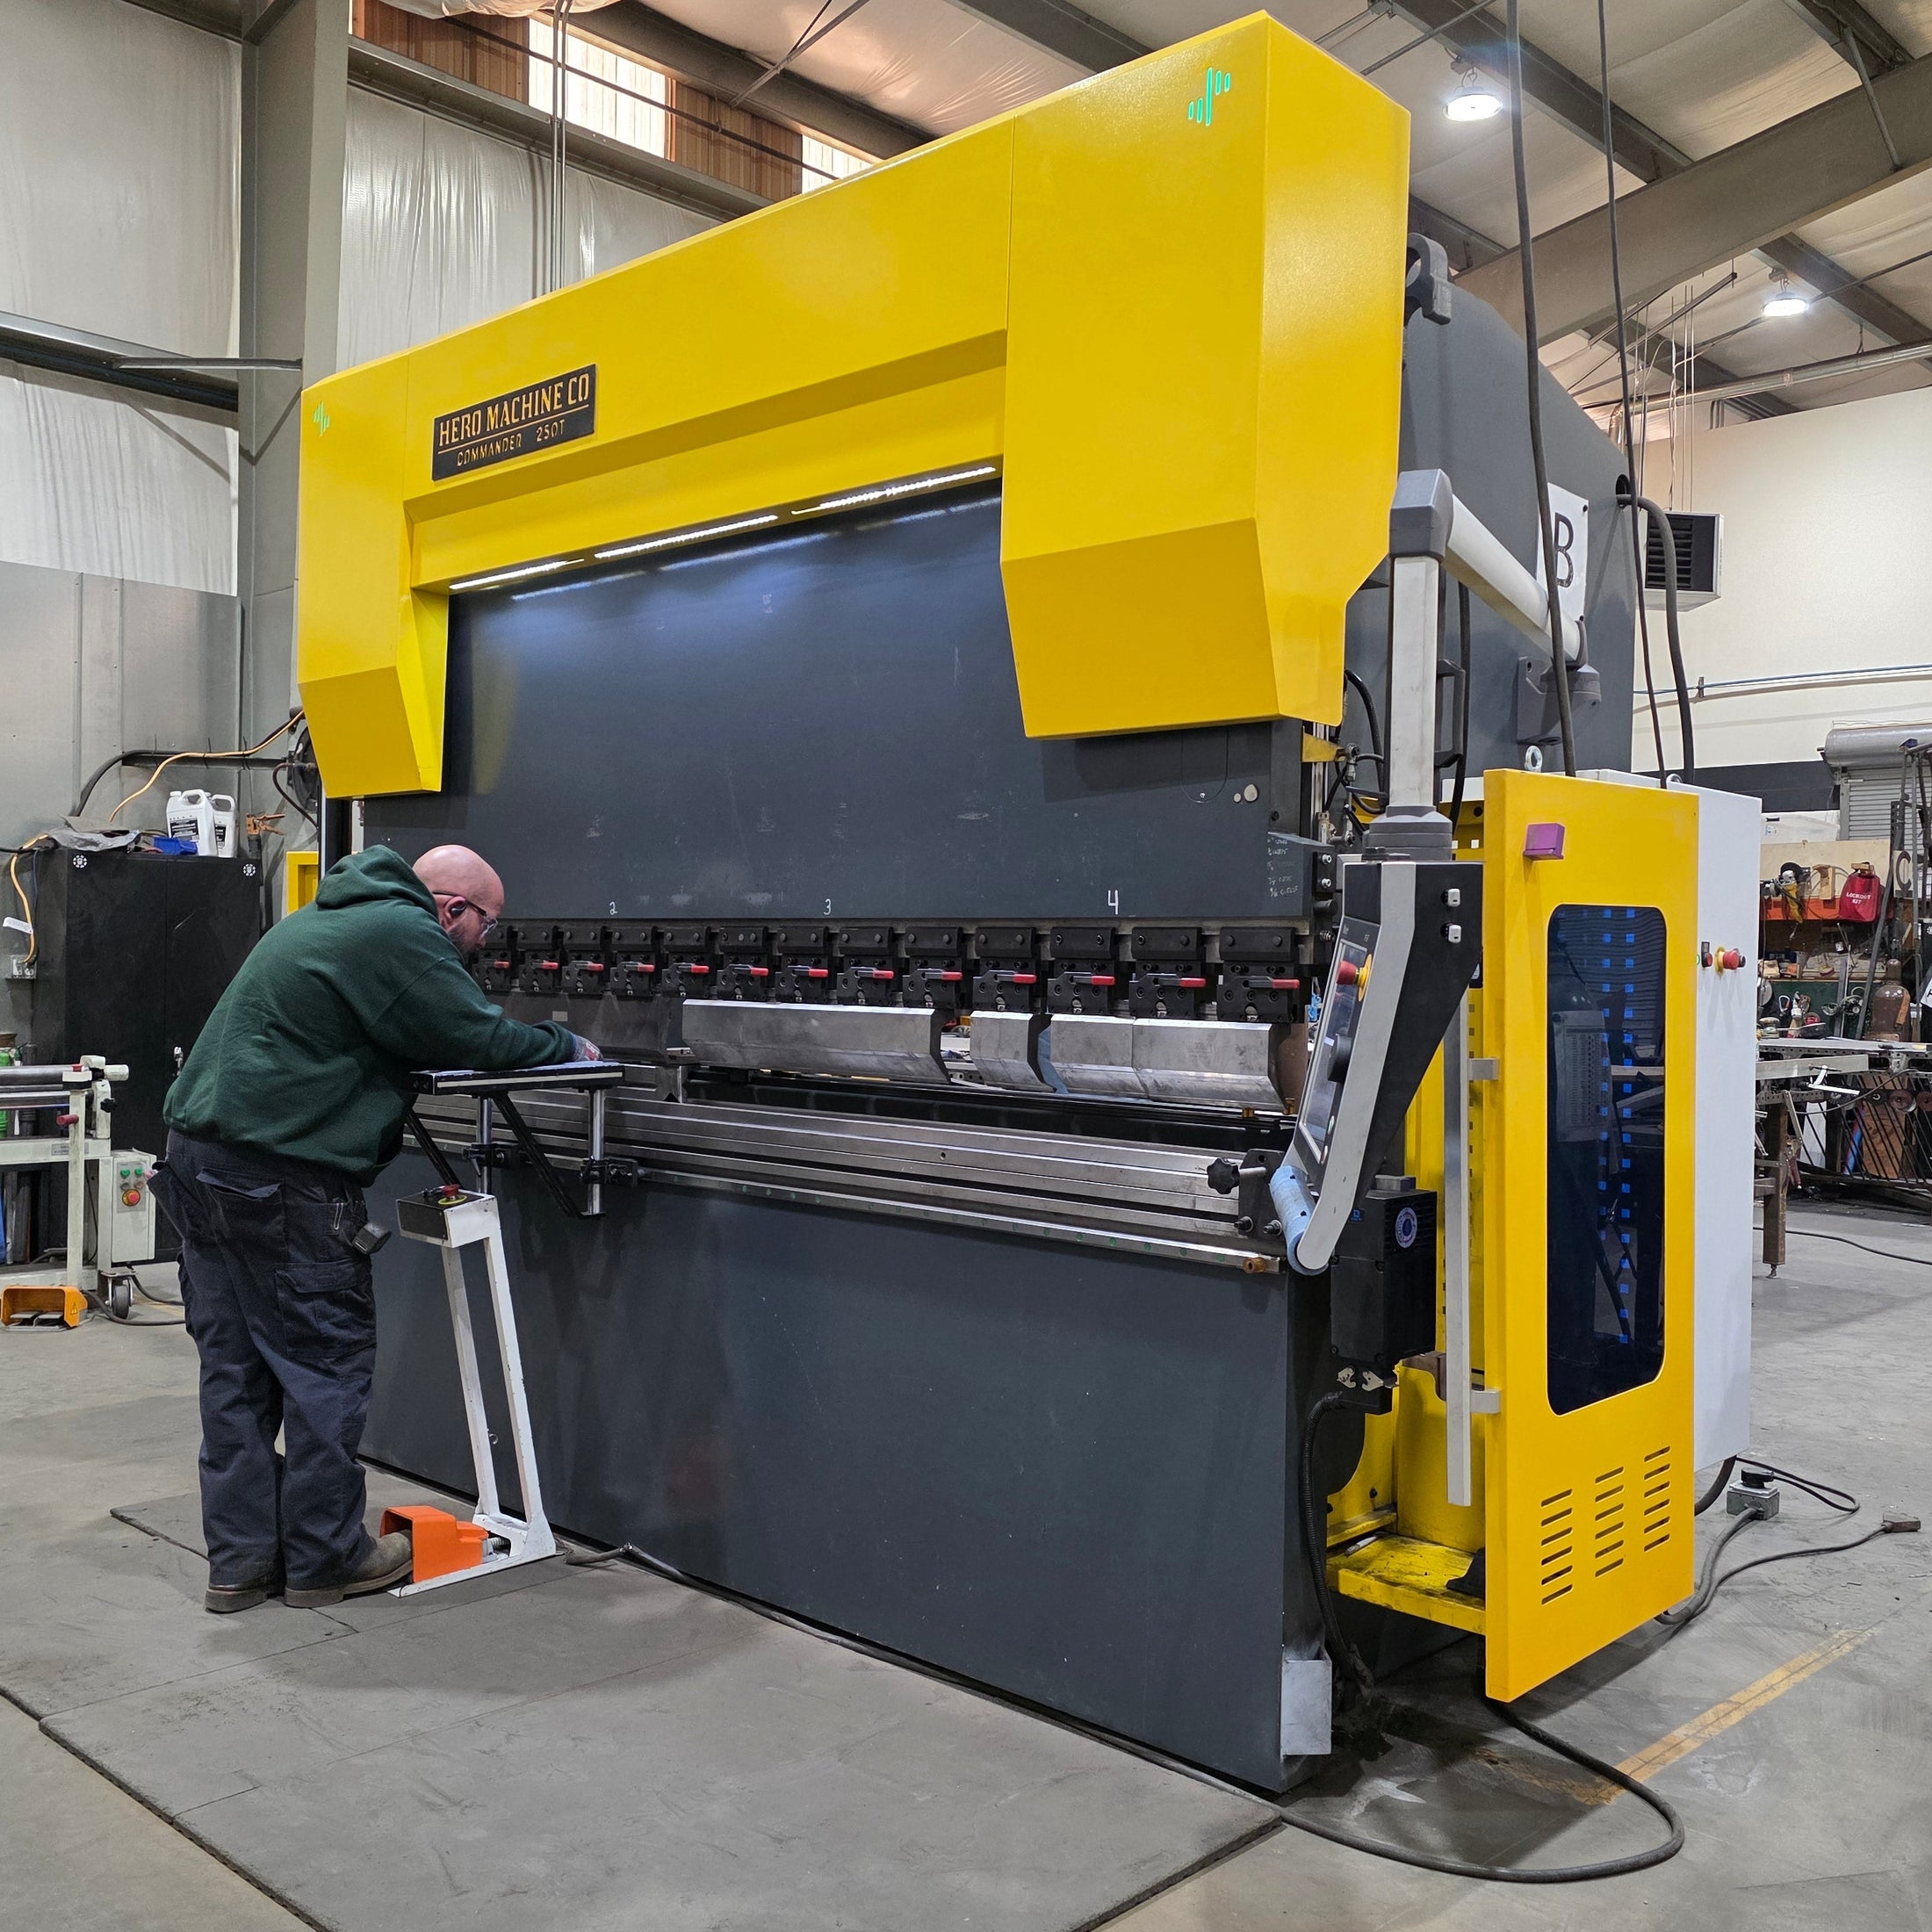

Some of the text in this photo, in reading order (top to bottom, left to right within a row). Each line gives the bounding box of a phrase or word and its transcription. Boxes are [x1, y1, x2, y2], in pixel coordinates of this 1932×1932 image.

[439, 373, 589, 446] HERO MACHINE CO
[457, 419, 565, 466] COMMANDER 250T
[1554, 512, 1574, 588] B
[1895, 850, 1912, 890] C
[609, 901, 618, 915] 2
[823, 898, 832, 915] 3
[1107, 890, 1119, 915] 4
[1846, 891, 1871, 900] LOCKOUT
